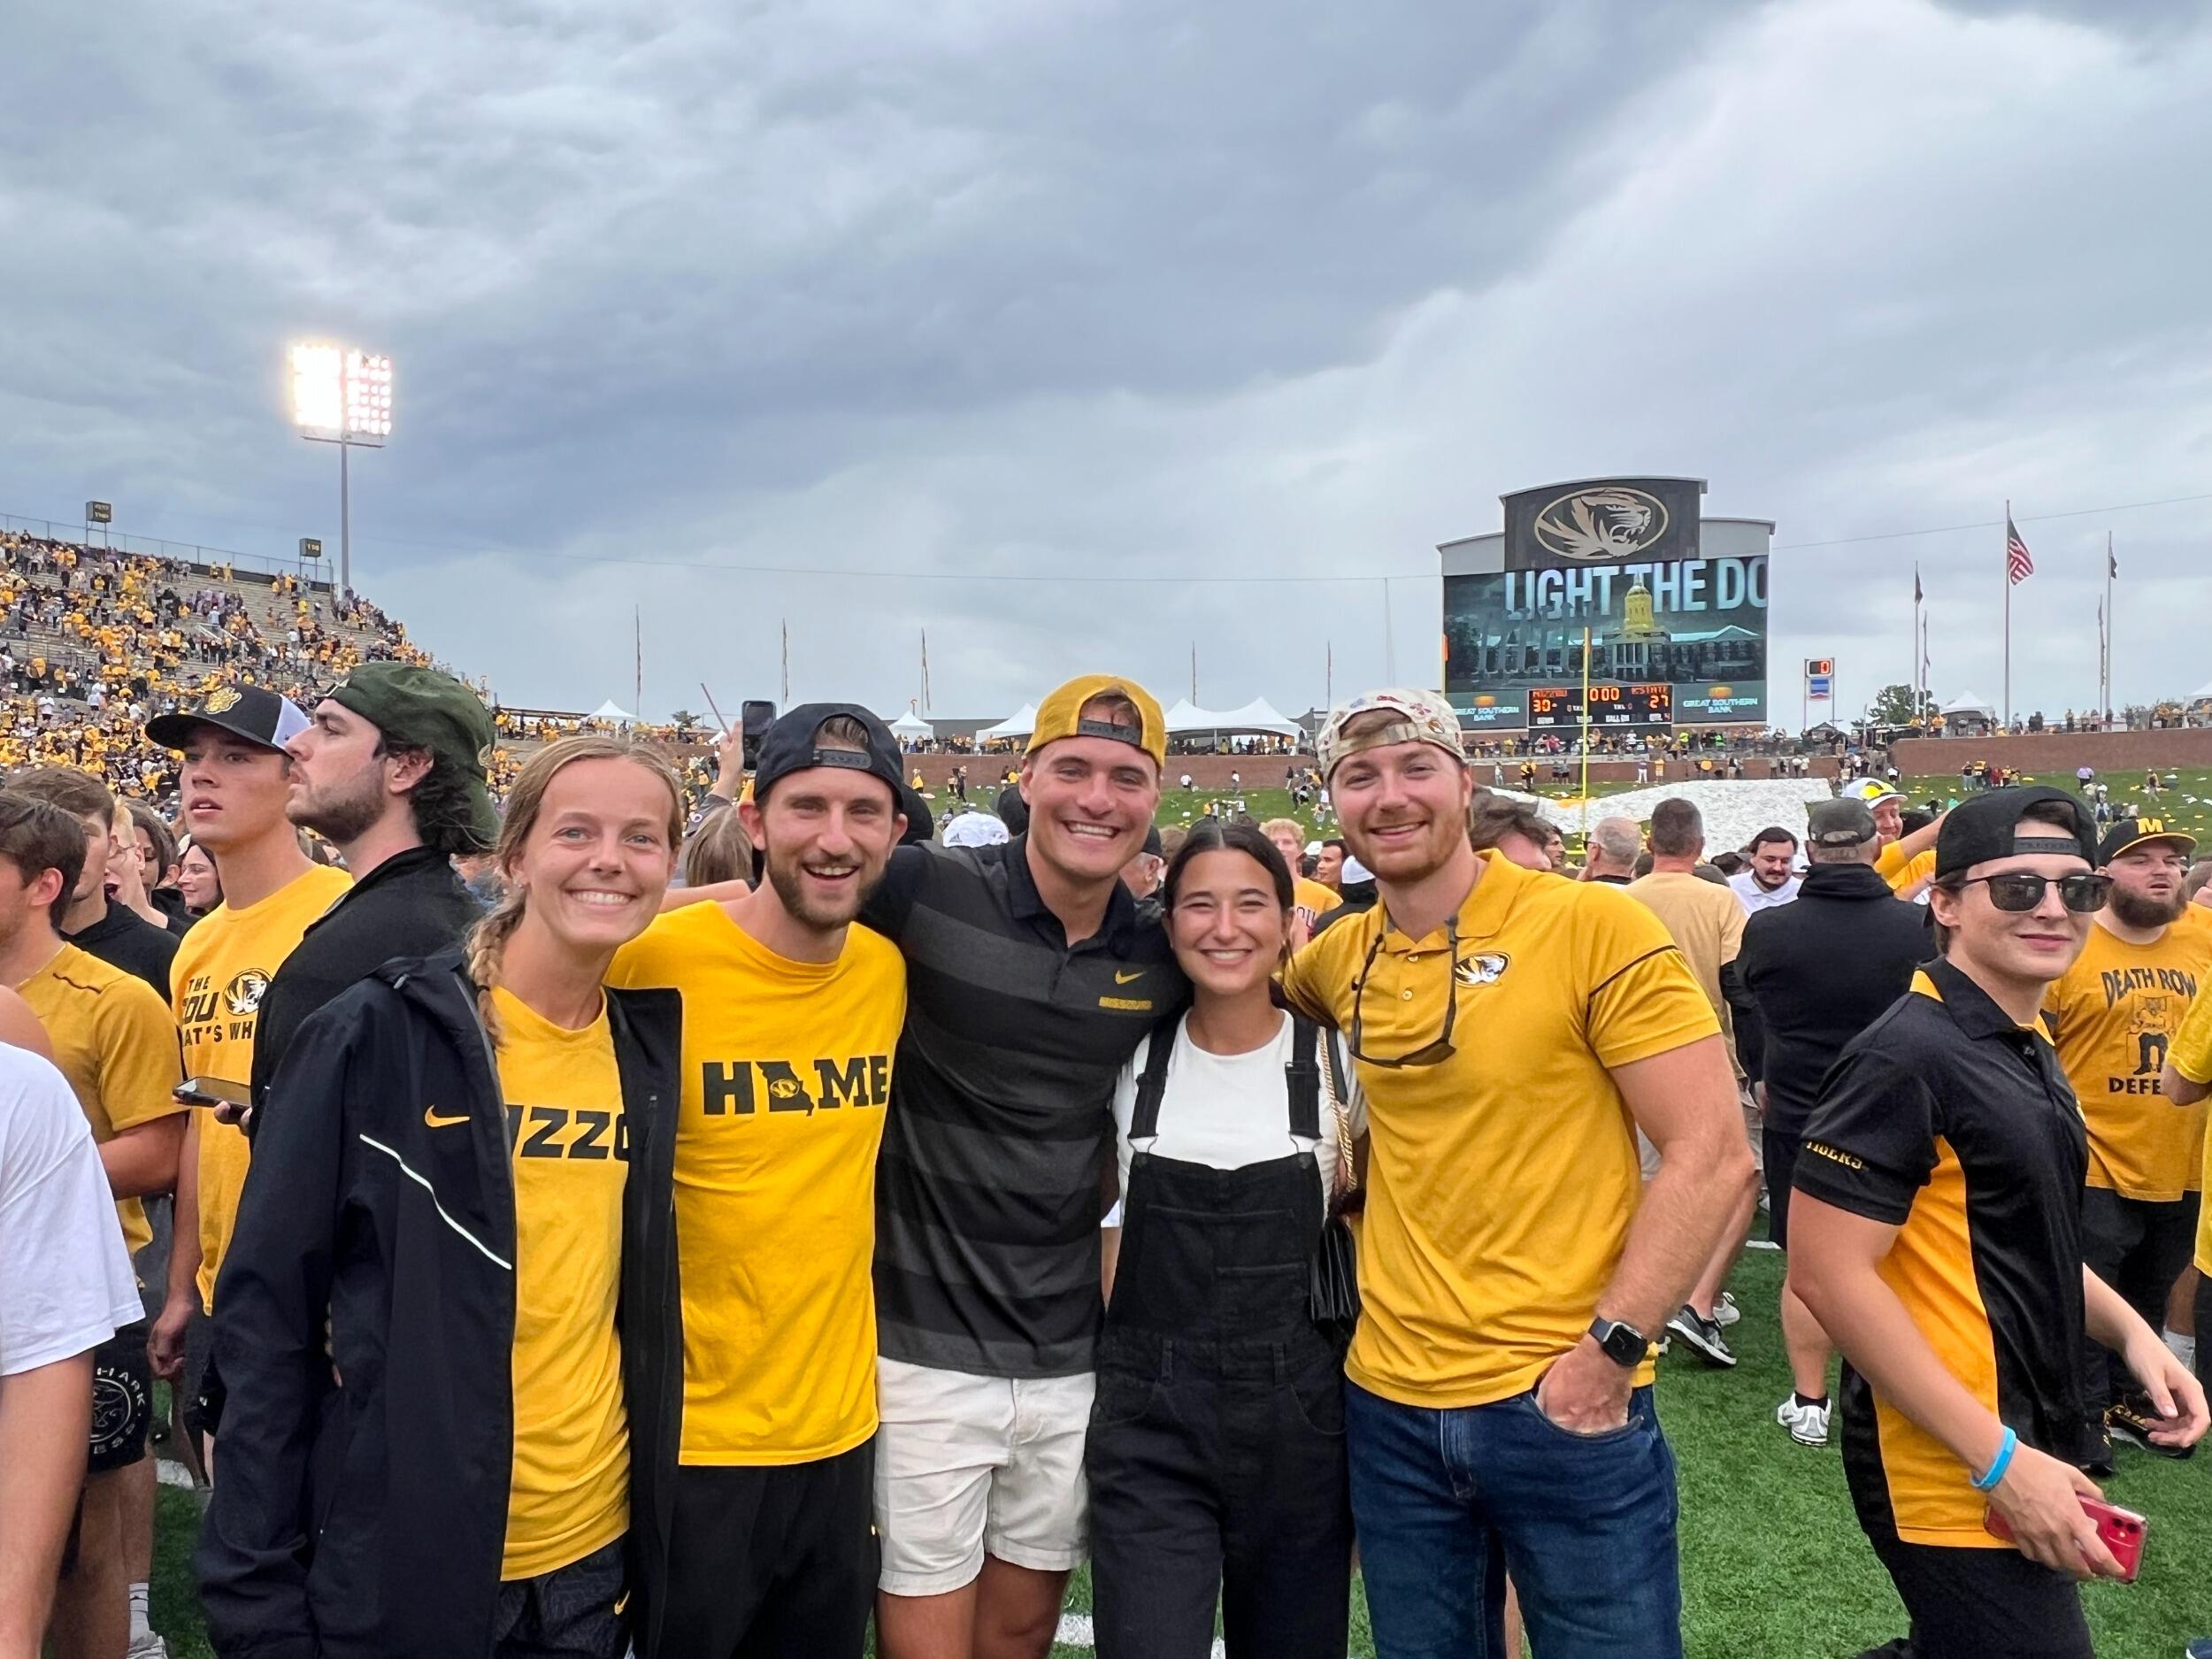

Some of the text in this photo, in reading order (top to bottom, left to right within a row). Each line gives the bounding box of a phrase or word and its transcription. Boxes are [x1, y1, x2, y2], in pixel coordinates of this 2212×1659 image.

[1505, 565, 1619, 620] LIGHT
[1624, 559, 1707, 614] THE
[1649, 695, 1669, 709] 27
[2136, 818, 2163, 834] M
[188, 975, 211, 992] THE
[2101, 967, 2198, 1009] DEATH ROW
[184, 1020, 254, 1047] AT'S WH
[703, 1055, 889, 1116] HME
[2108, 1077, 2162, 1095] DEFE
[505, 1104, 630, 1161] IZZ
